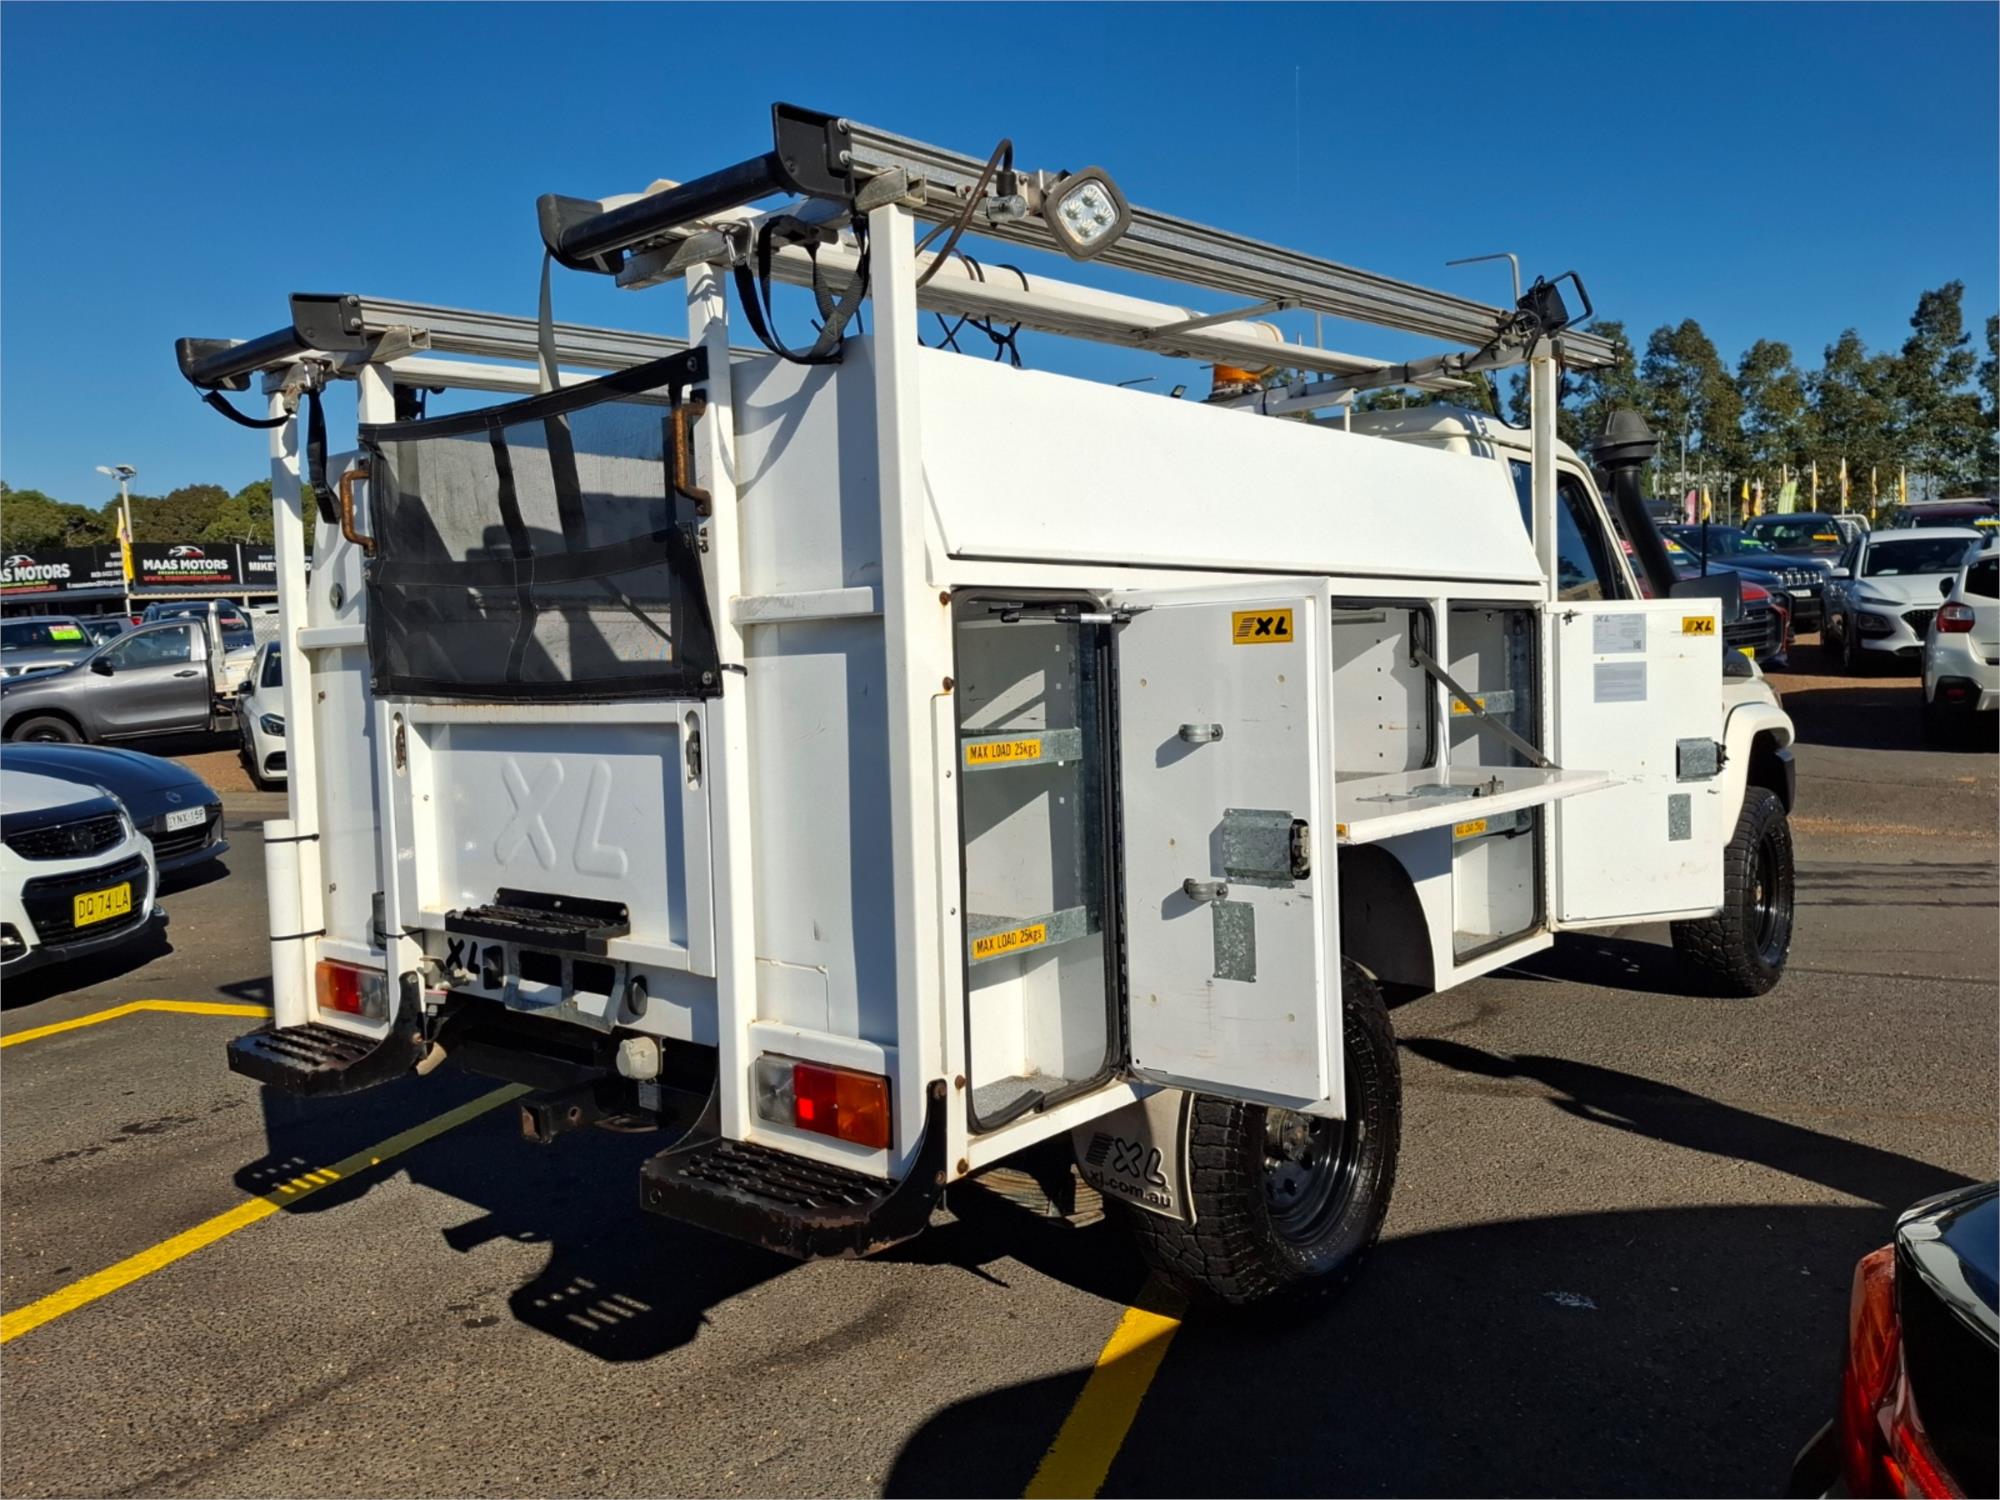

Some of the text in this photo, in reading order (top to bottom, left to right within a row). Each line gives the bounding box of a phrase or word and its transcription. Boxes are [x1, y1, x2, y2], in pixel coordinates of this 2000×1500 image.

[14, 563, 71, 581] MOTORS
[143, 559, 229, 570] MAAS MOTORS
[248, 561, 276, 571] MIKE'
[1255, 616, 1288, 636] XL
[1694, 620, 1712, 632] XL
[970, 742, 1037, 760] MAX LOAD 25kgs
[494, 756, 628, 880] XL
[976, 928, 1042, 954] MAX LOAD 25kgs
[1113, 1137, 1168, 1187] XL
